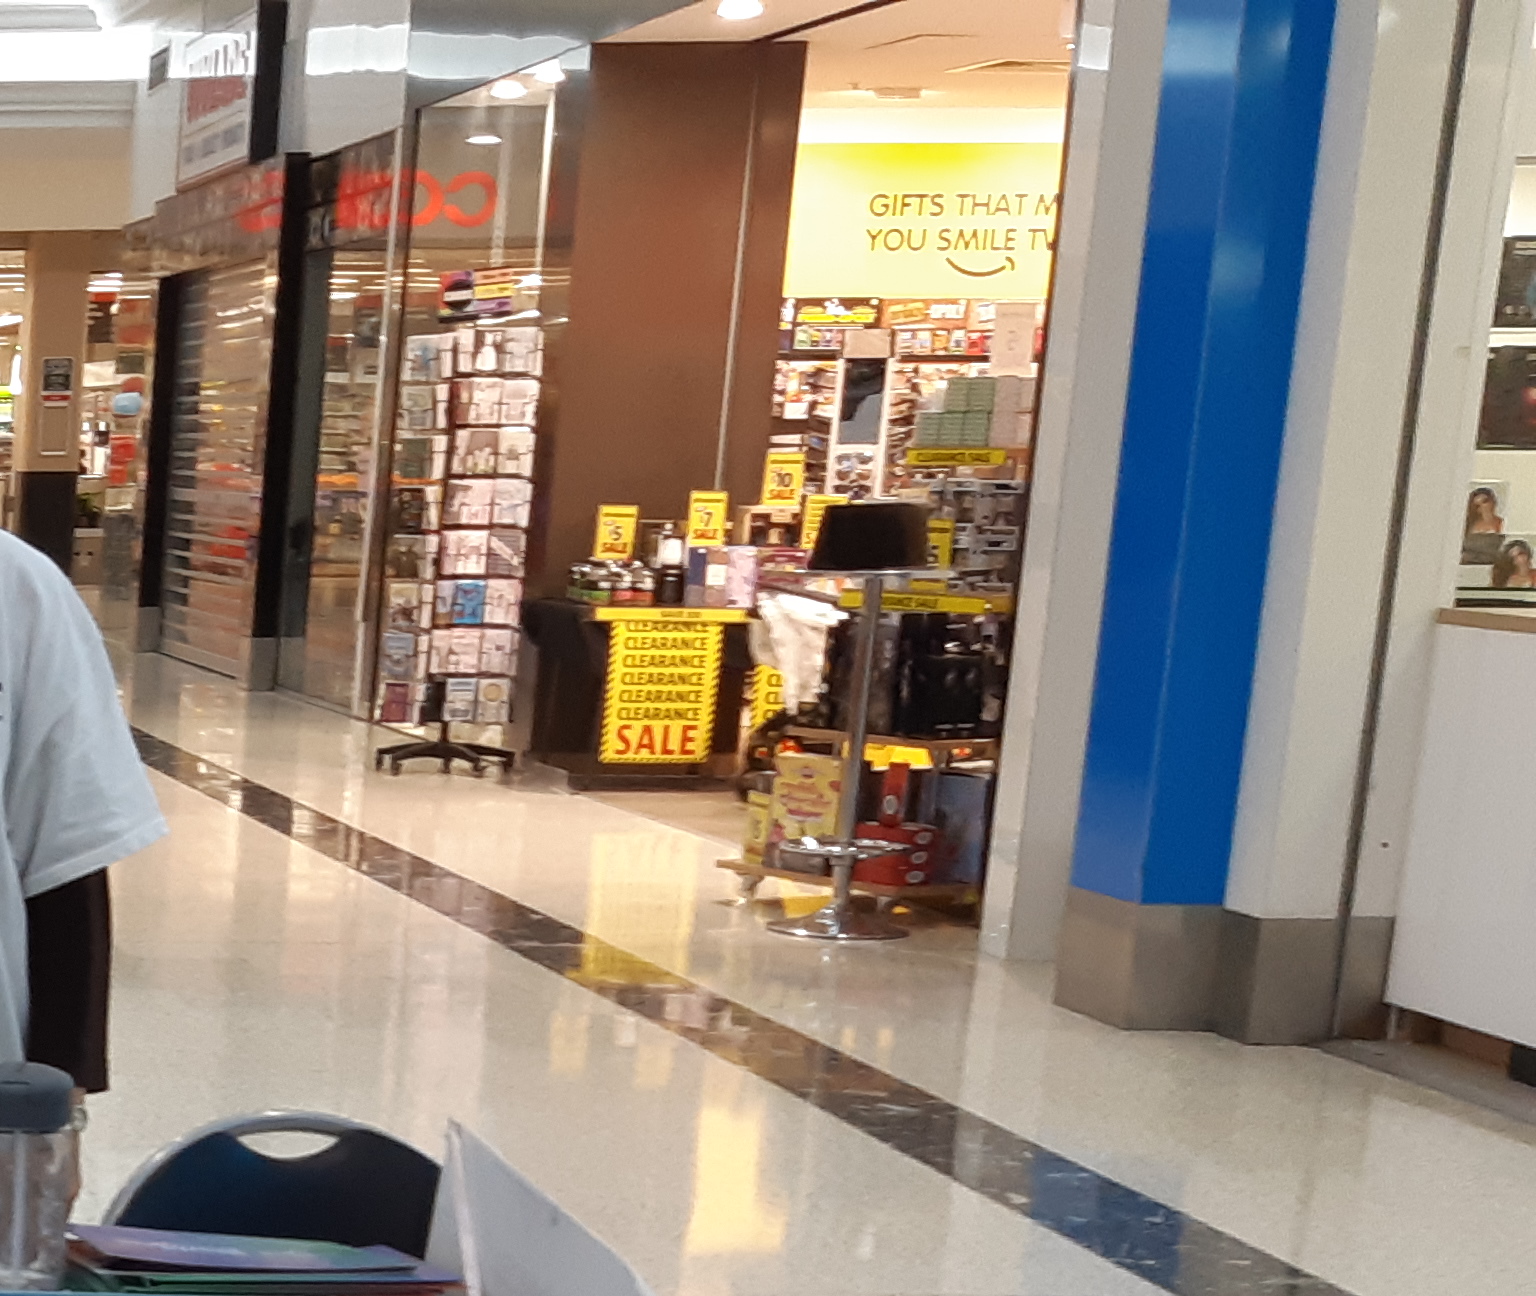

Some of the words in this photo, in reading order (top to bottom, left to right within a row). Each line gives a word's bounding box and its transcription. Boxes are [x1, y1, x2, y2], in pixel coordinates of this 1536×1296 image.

[869, 194, 945, 217] GIFTS
[956, 194, 1028, 216] THAT
[866, 229, 927, 251] YOU
[937, 228, 1017, 251] SMILE
[625, 637, 709, 650] CLEARANCE
[622, 654, 706, 668] CLEARANCE
[621, 672, 705, 686] CLEARANCE
[619, 690, 703, 703] CLEARANCE
[617, 707, 702, 720] CLEARANCE
[615, 725, 698, 755] SALE
